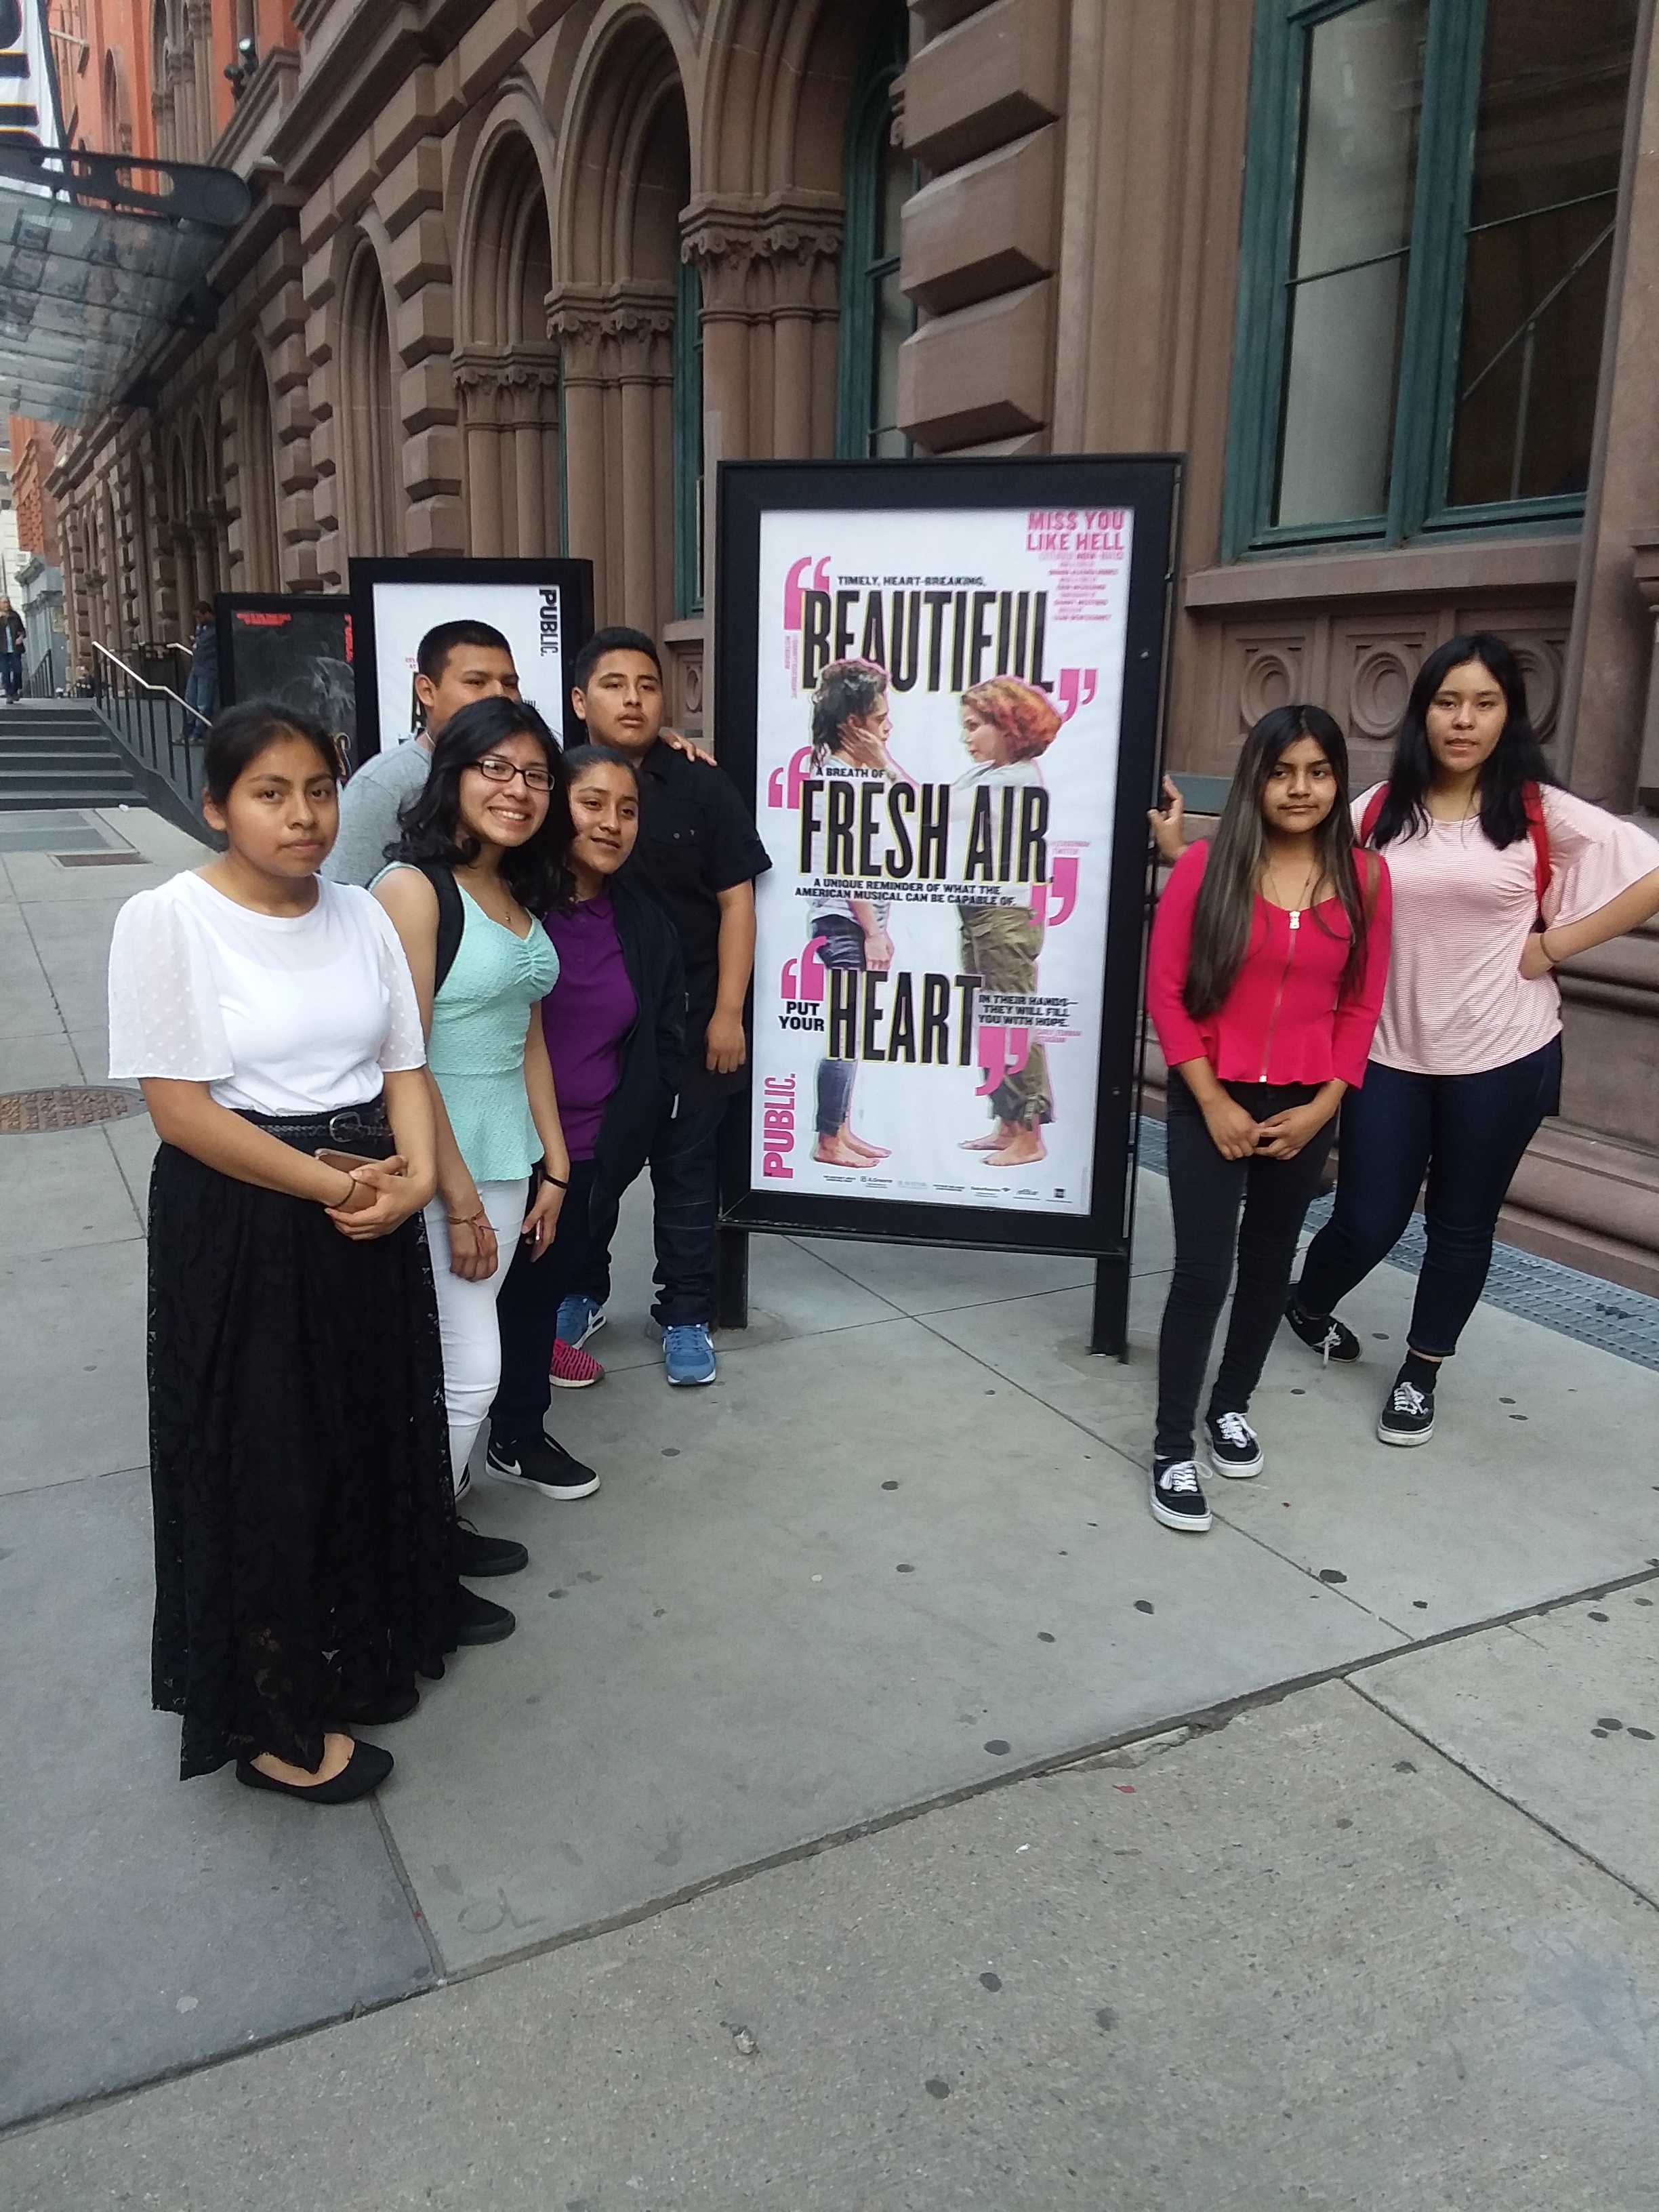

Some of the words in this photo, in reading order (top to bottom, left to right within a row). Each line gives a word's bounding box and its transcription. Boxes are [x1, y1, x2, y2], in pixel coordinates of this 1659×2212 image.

[1027, 511, 1078, 530] MISS
[1085, 511, 1125, 530] YOU
[1027, 533, 1069, 550] LIKE
[1076, 533, 1124, 550] HELL
[838, 576, 880, 586] TIMELY,
[539, 589, 559, 657] PUBLIC.
[802, 590, 1055, 693] BEAUTIFUL
[816, 767, 823, 777] A
[826, 768, 868, 778] BREATH
[872, 769, 886, 779] OF
[800, 779, 950, 881] FRESH
[813, 878, 821, 887] A
[823, 879, 863, 889] UNIQUE
[866, 881, 924, 892] REMINDER
[926, 883, 941, 892] OF
[943, 884, 977, 894] WHAT
[979, 885, 1002, 895] THE
[795, 887, 851, 899] AMERICAN
[854, 890, 903, 901] MUSICAL
[905, 893, 928, 902] CAN
[931, 893, 945, 903] BE
[947, 895, 998, 905] CAPABLE
[786, 1001, 820, 1016] PUT
[983, 1005, 1013, 1015] THEY
[1017, 1006, 1043, 1016] WILL
[1046, 1008, 1071, 1017] FILL
[779, 1016, 825, 1031] YOUR
[827, 968, 983, 1067] HEART
[979, 1015, 1002, 1023] YOU
[1004, 1017, 1033, 1025] WITH
[763, 1073, 796, 1179] PUBLIC.
